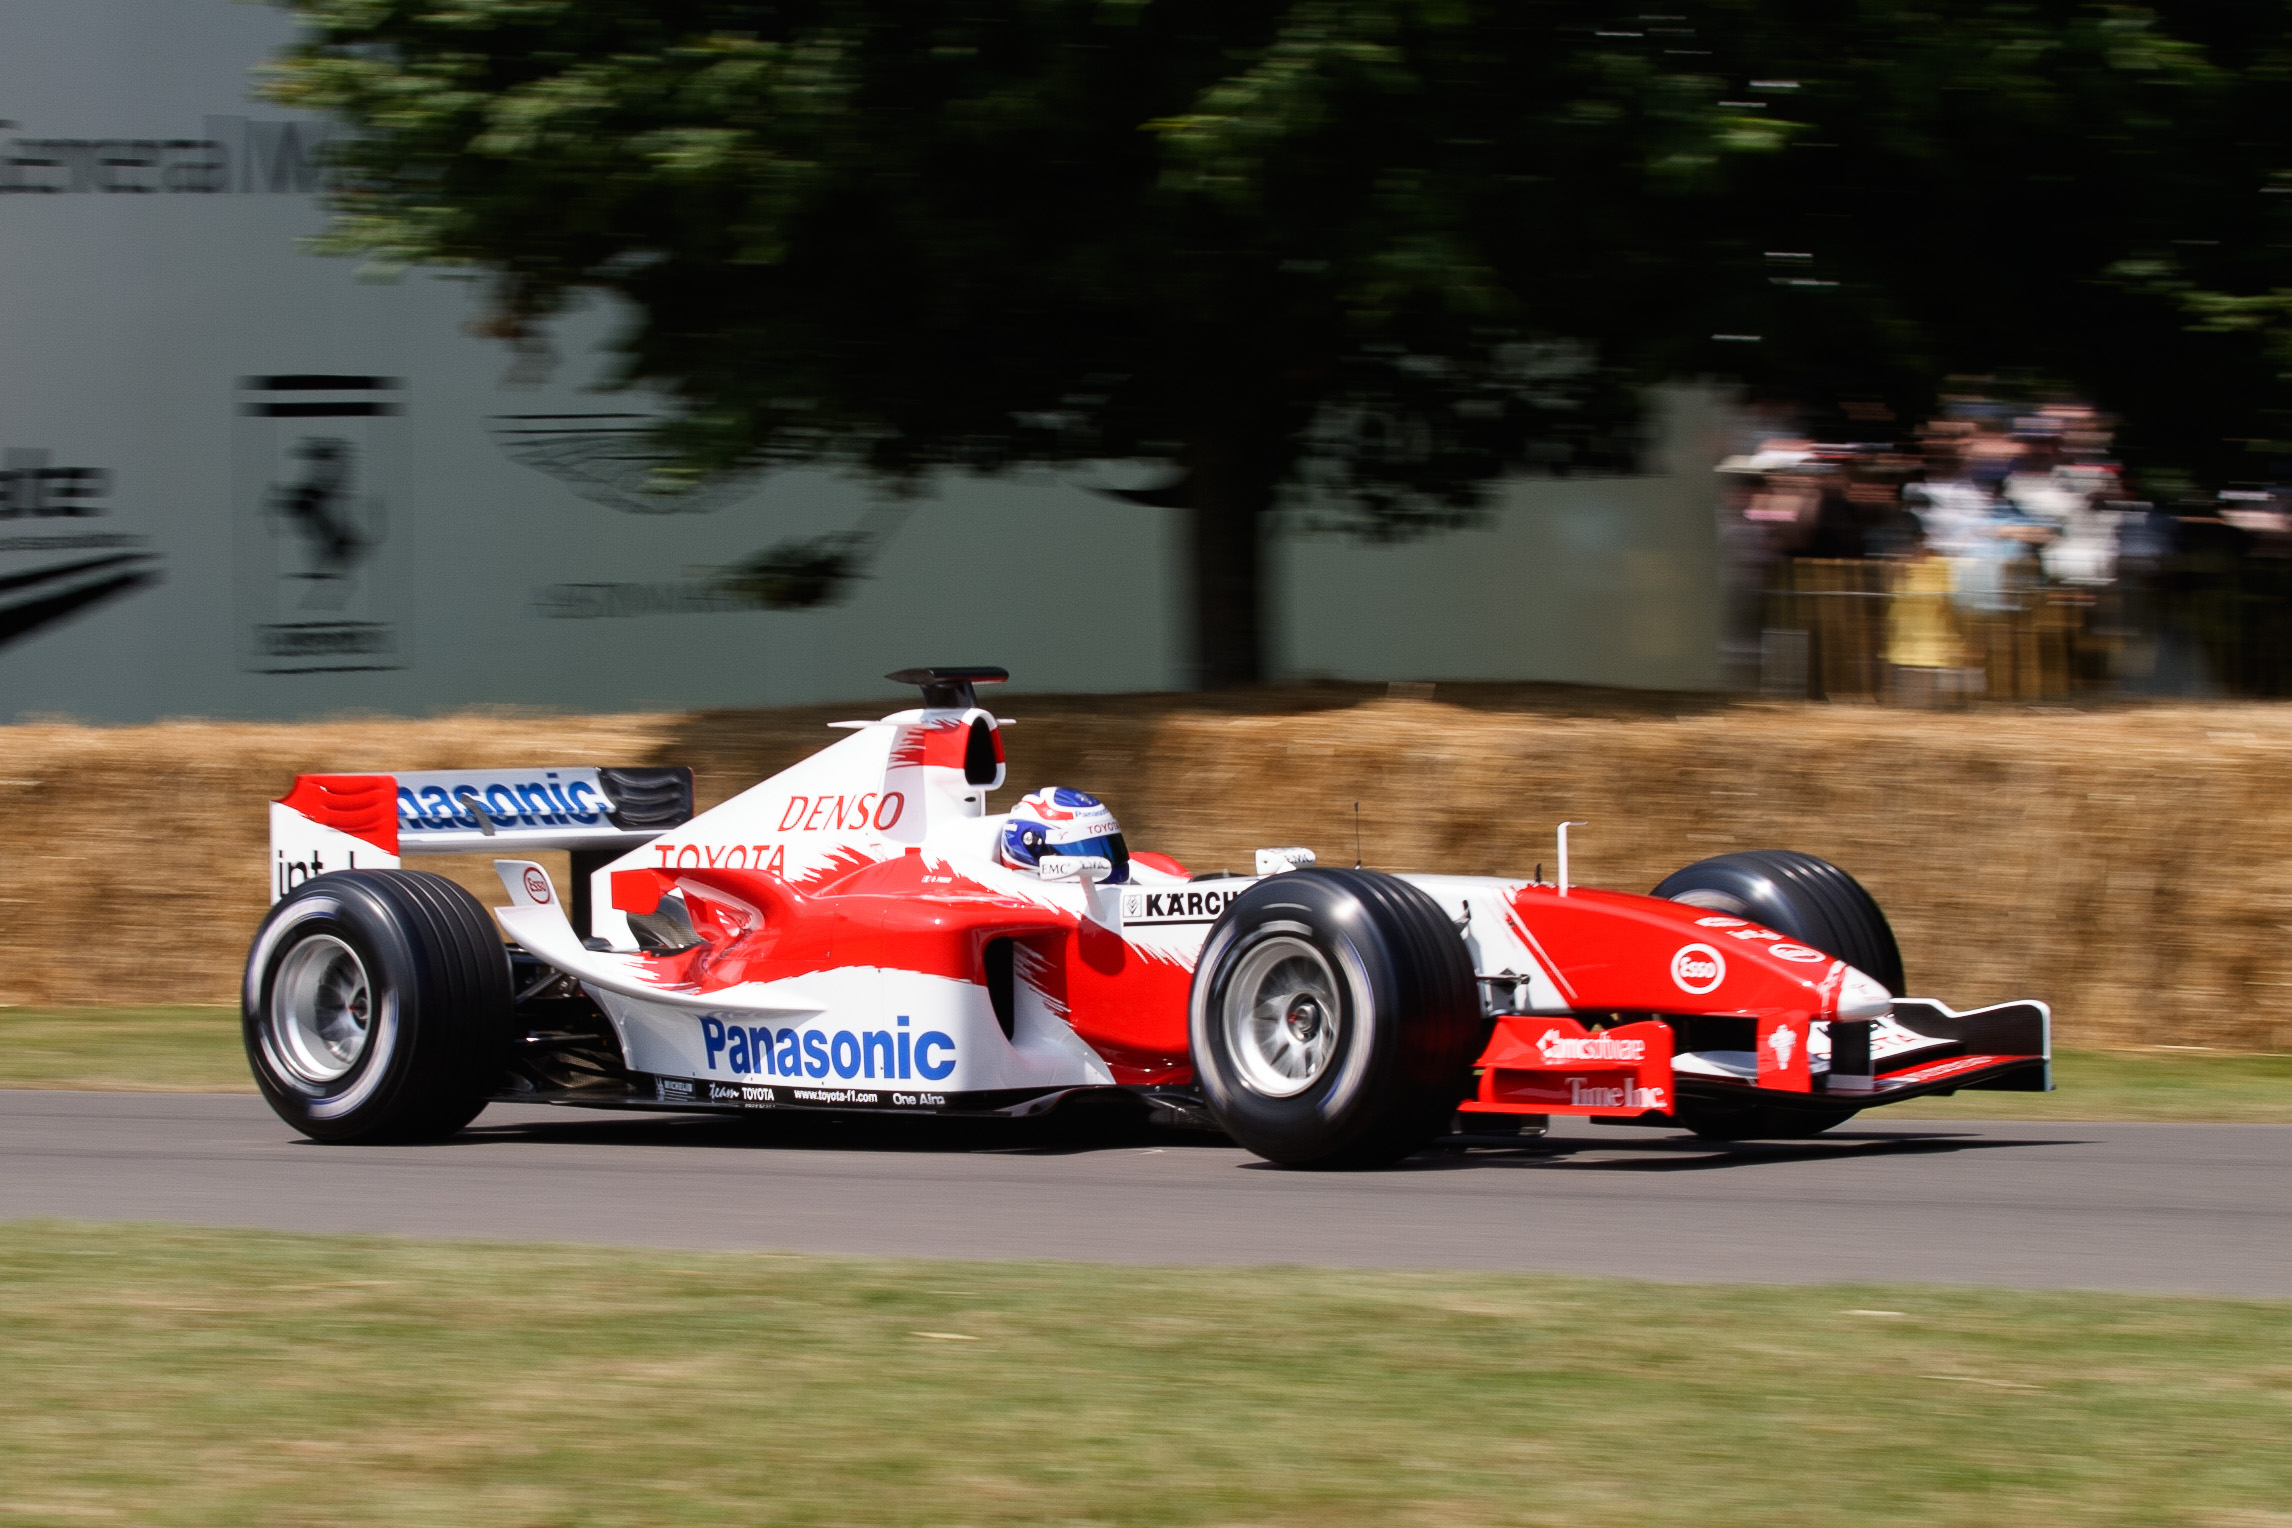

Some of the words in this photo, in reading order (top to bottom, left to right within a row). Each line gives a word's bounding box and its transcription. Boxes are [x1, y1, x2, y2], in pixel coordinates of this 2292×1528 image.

[777, 792, 905, 832] DENSO
[1146, 891, 1242, 917] KÄRCH
[1679, 957, 1717, 978] Esso
[700, 1015, 957, 1081] Panasonic
[741, 1087, 775, 1101] TOYOTA
[794, 1089, 878, 1103] www.toyota-f1.com
[892, 1092, 917, 1106] One
